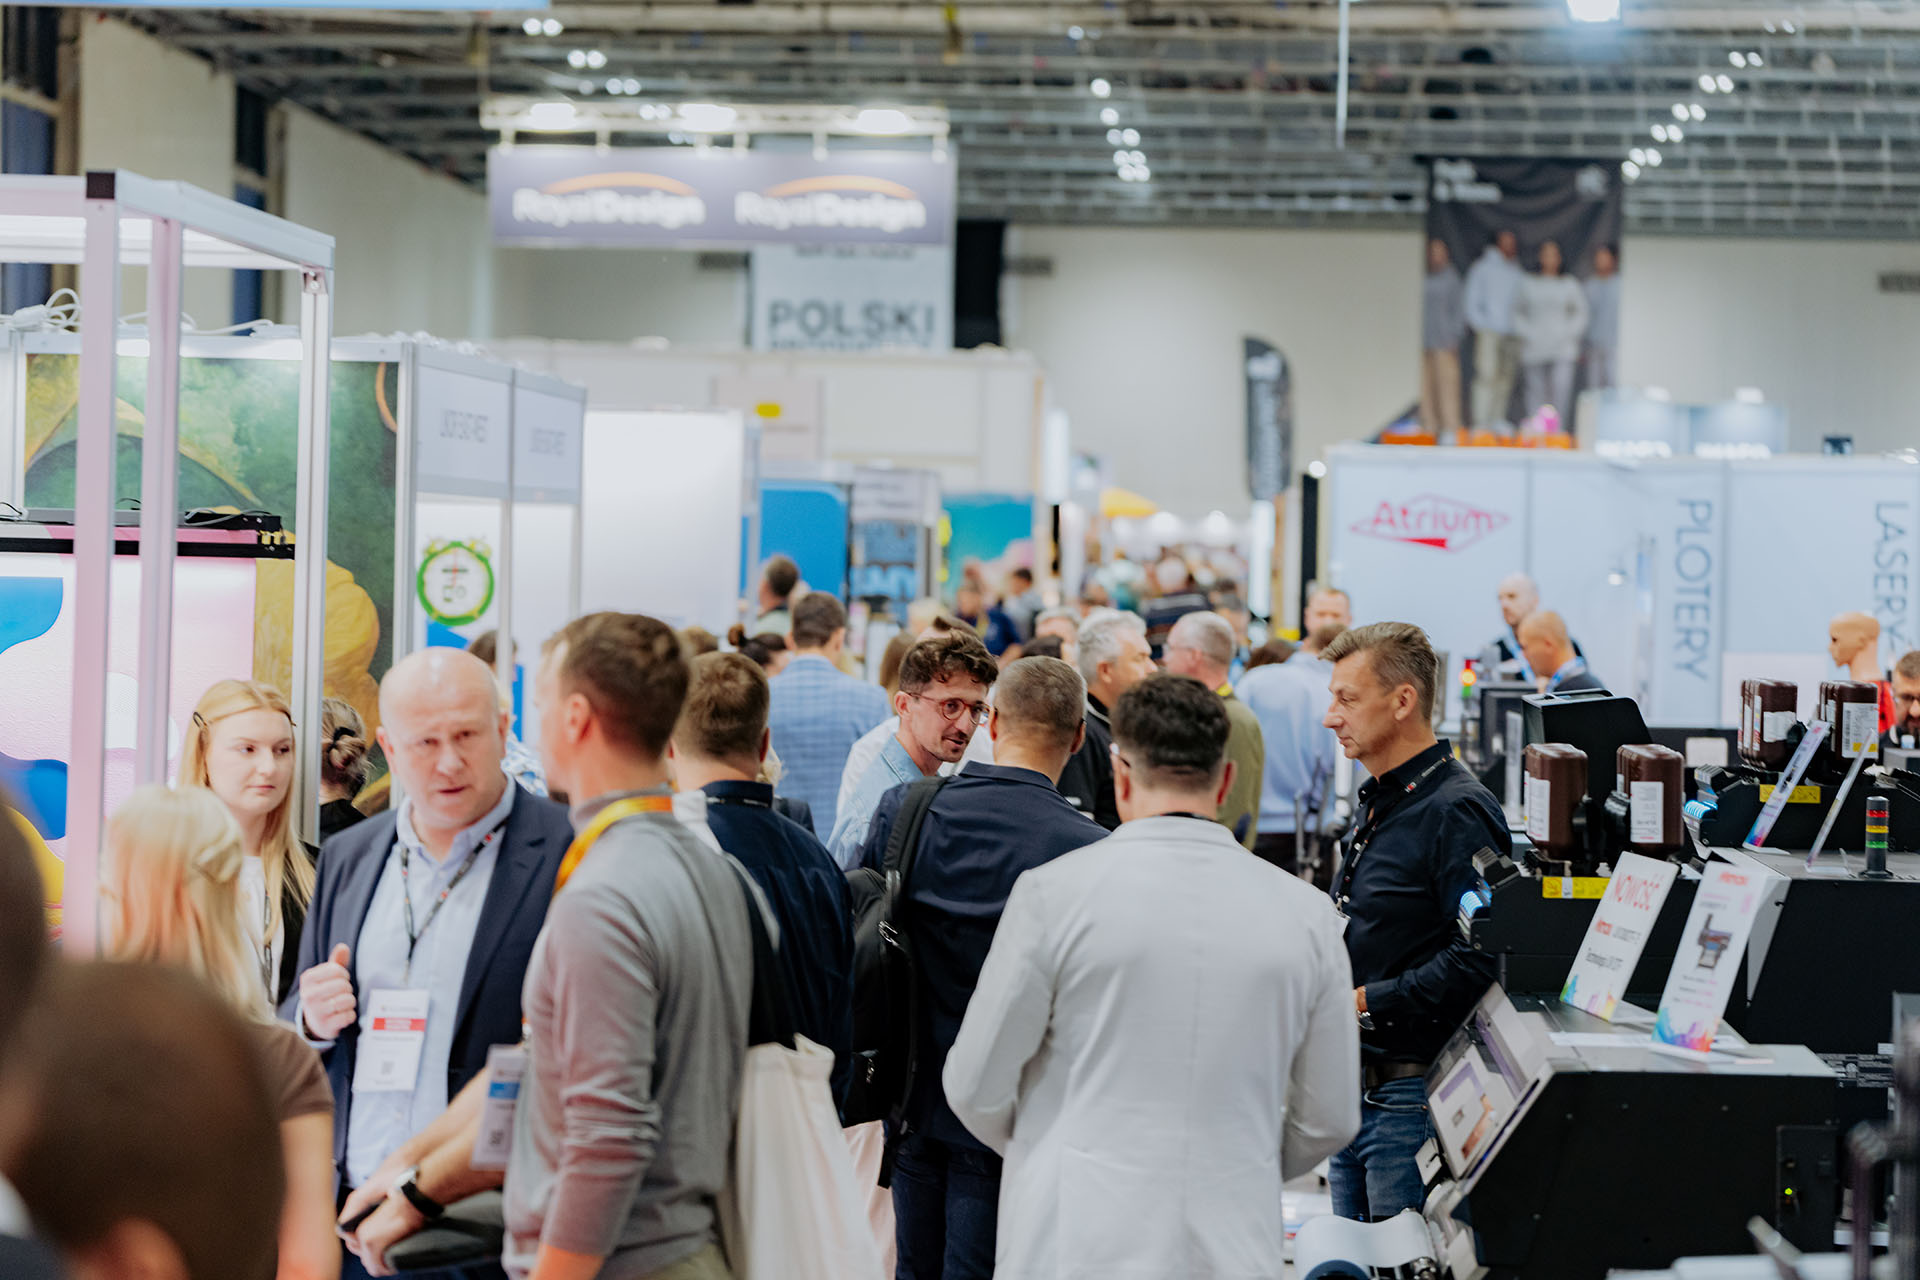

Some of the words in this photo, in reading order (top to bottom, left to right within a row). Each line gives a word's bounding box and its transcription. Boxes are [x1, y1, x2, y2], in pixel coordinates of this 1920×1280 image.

[768, 302, 935, 336] POLSKI
[1373, 499, 1493, 532] Atrium
[1674, 498, 1712, 681] PLOTERY
[1873, 501, 1909, 643] LASERY
